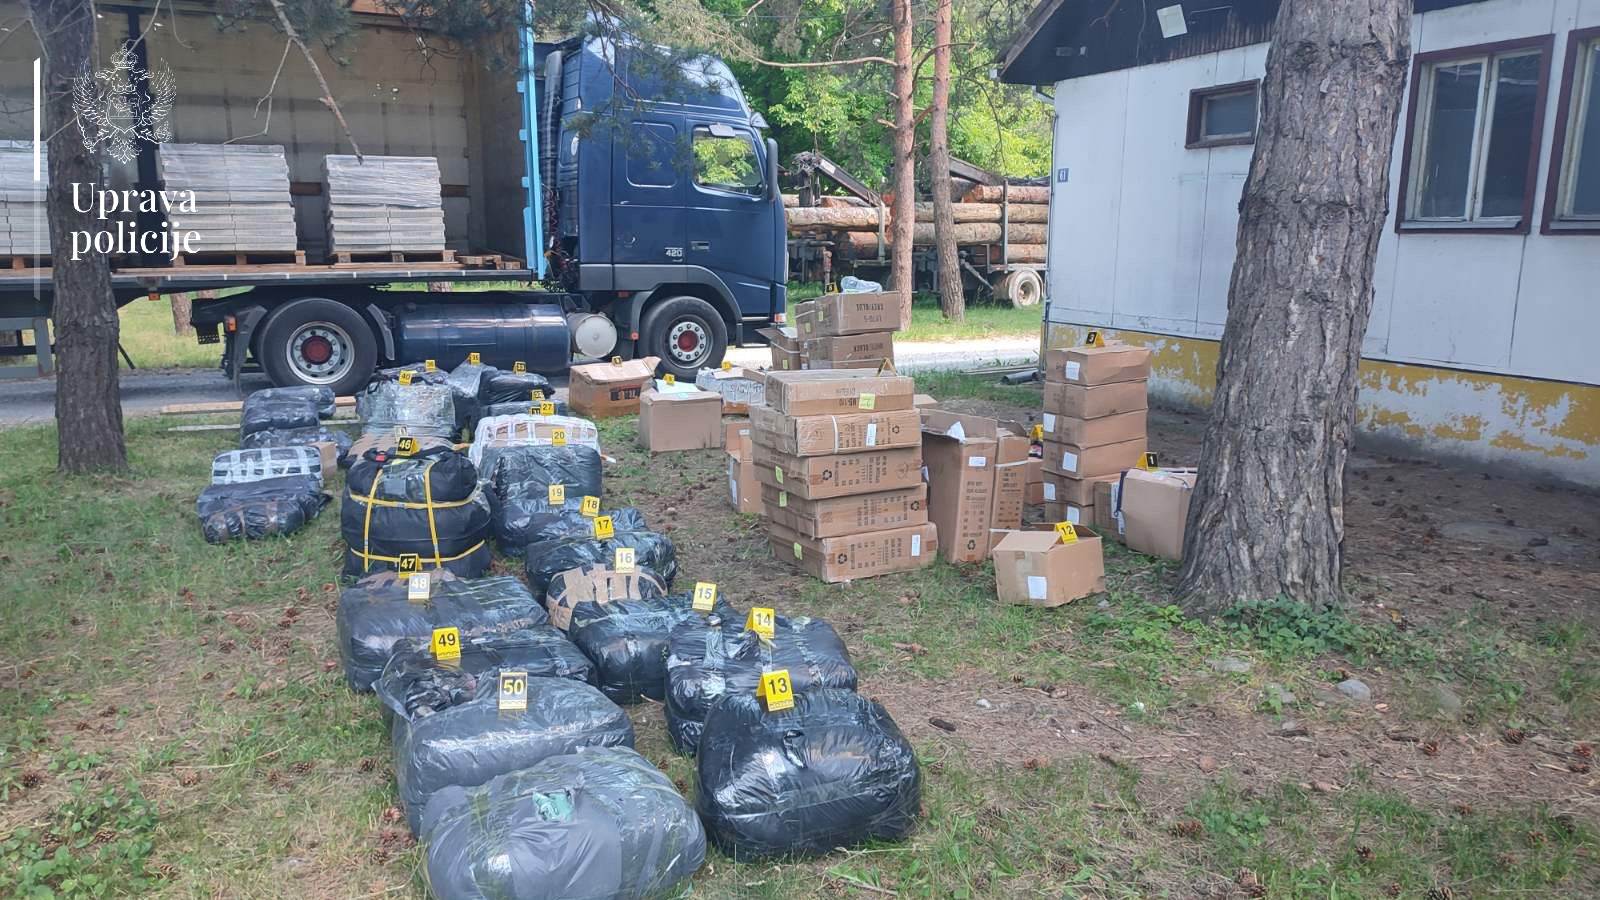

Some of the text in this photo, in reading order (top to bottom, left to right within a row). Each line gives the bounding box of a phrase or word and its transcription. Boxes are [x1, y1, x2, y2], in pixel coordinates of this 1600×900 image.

[666, 249, 682, 257] 420
[1089, 334, 1095, 343] 3
[543, 403, 552, 411] 27
[554, 431, 564, 440] 20
[399, 440, 411, 449] 46
[551, 488, 563, 497] 19
[587, 500, 598, 508] 18
[597, 519, 609, 529] 17
[1061, 525, 1074, 536] 12
[619, 553, 632, 563] 16
[401, 559, 415, 570] 47
[412, 577, 427, 588] 48
[697, 587, 712, 599] 15
[756, 613, 771, 625] 14
[438, 633, 456, 646] 49
[503, 679, 524, 694] 50
[768, 678, 788, 695] 13
